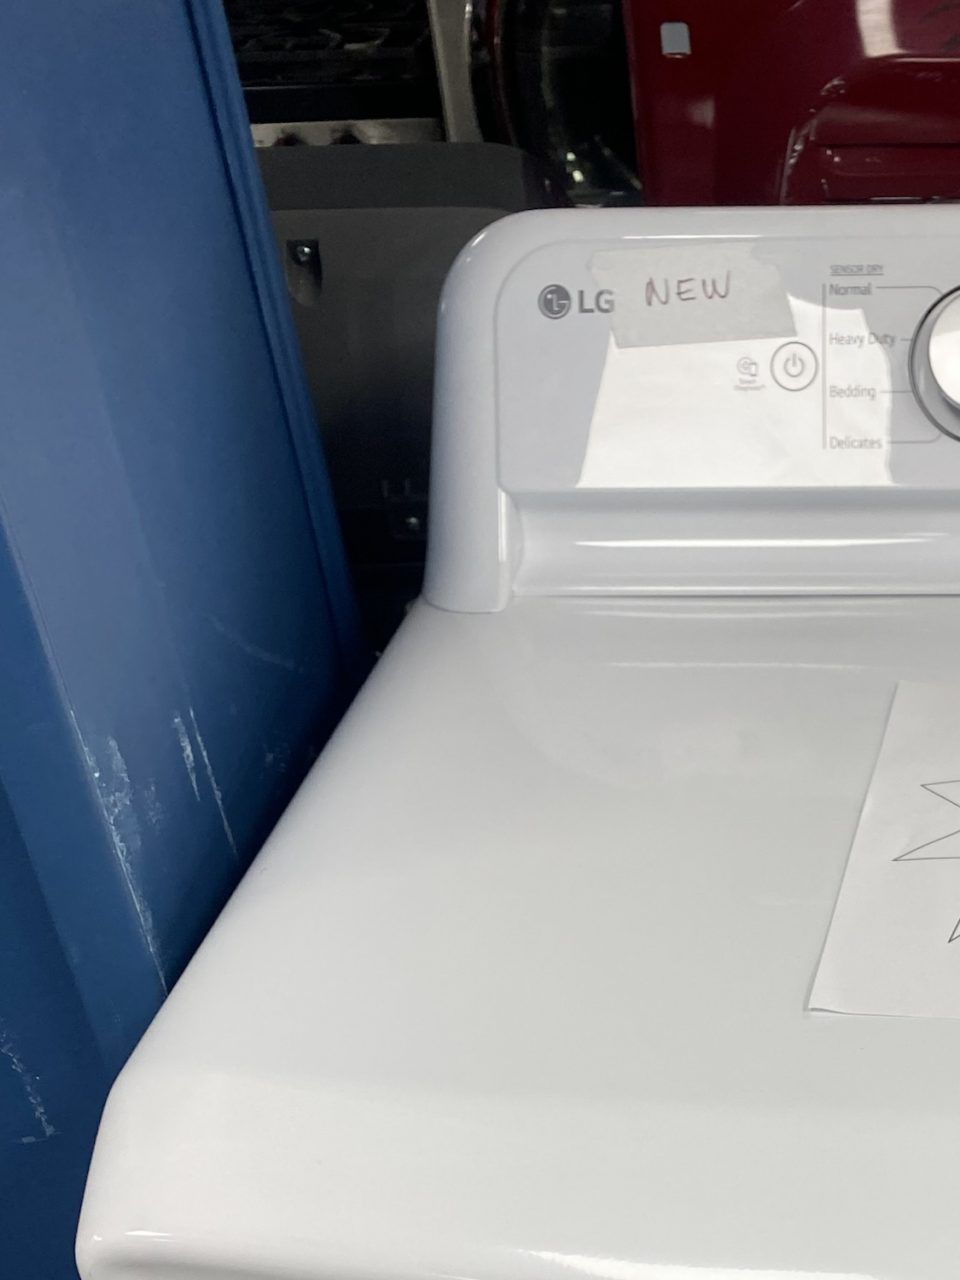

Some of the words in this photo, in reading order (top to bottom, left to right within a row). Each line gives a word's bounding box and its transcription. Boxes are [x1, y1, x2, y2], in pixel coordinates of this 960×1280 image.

[866, 264, 884, 274] DRY
[645, 270, 732, 306] NEW
[829, 282, 872, 296] Normal
[577, 289, 615, 314] LG
[829, 332, 865, 349] Heavy
[867, 331, 896, 348] Duty
[829, 385, 877, 401] Bedding
[829, 436, 883, 449] Delicates
